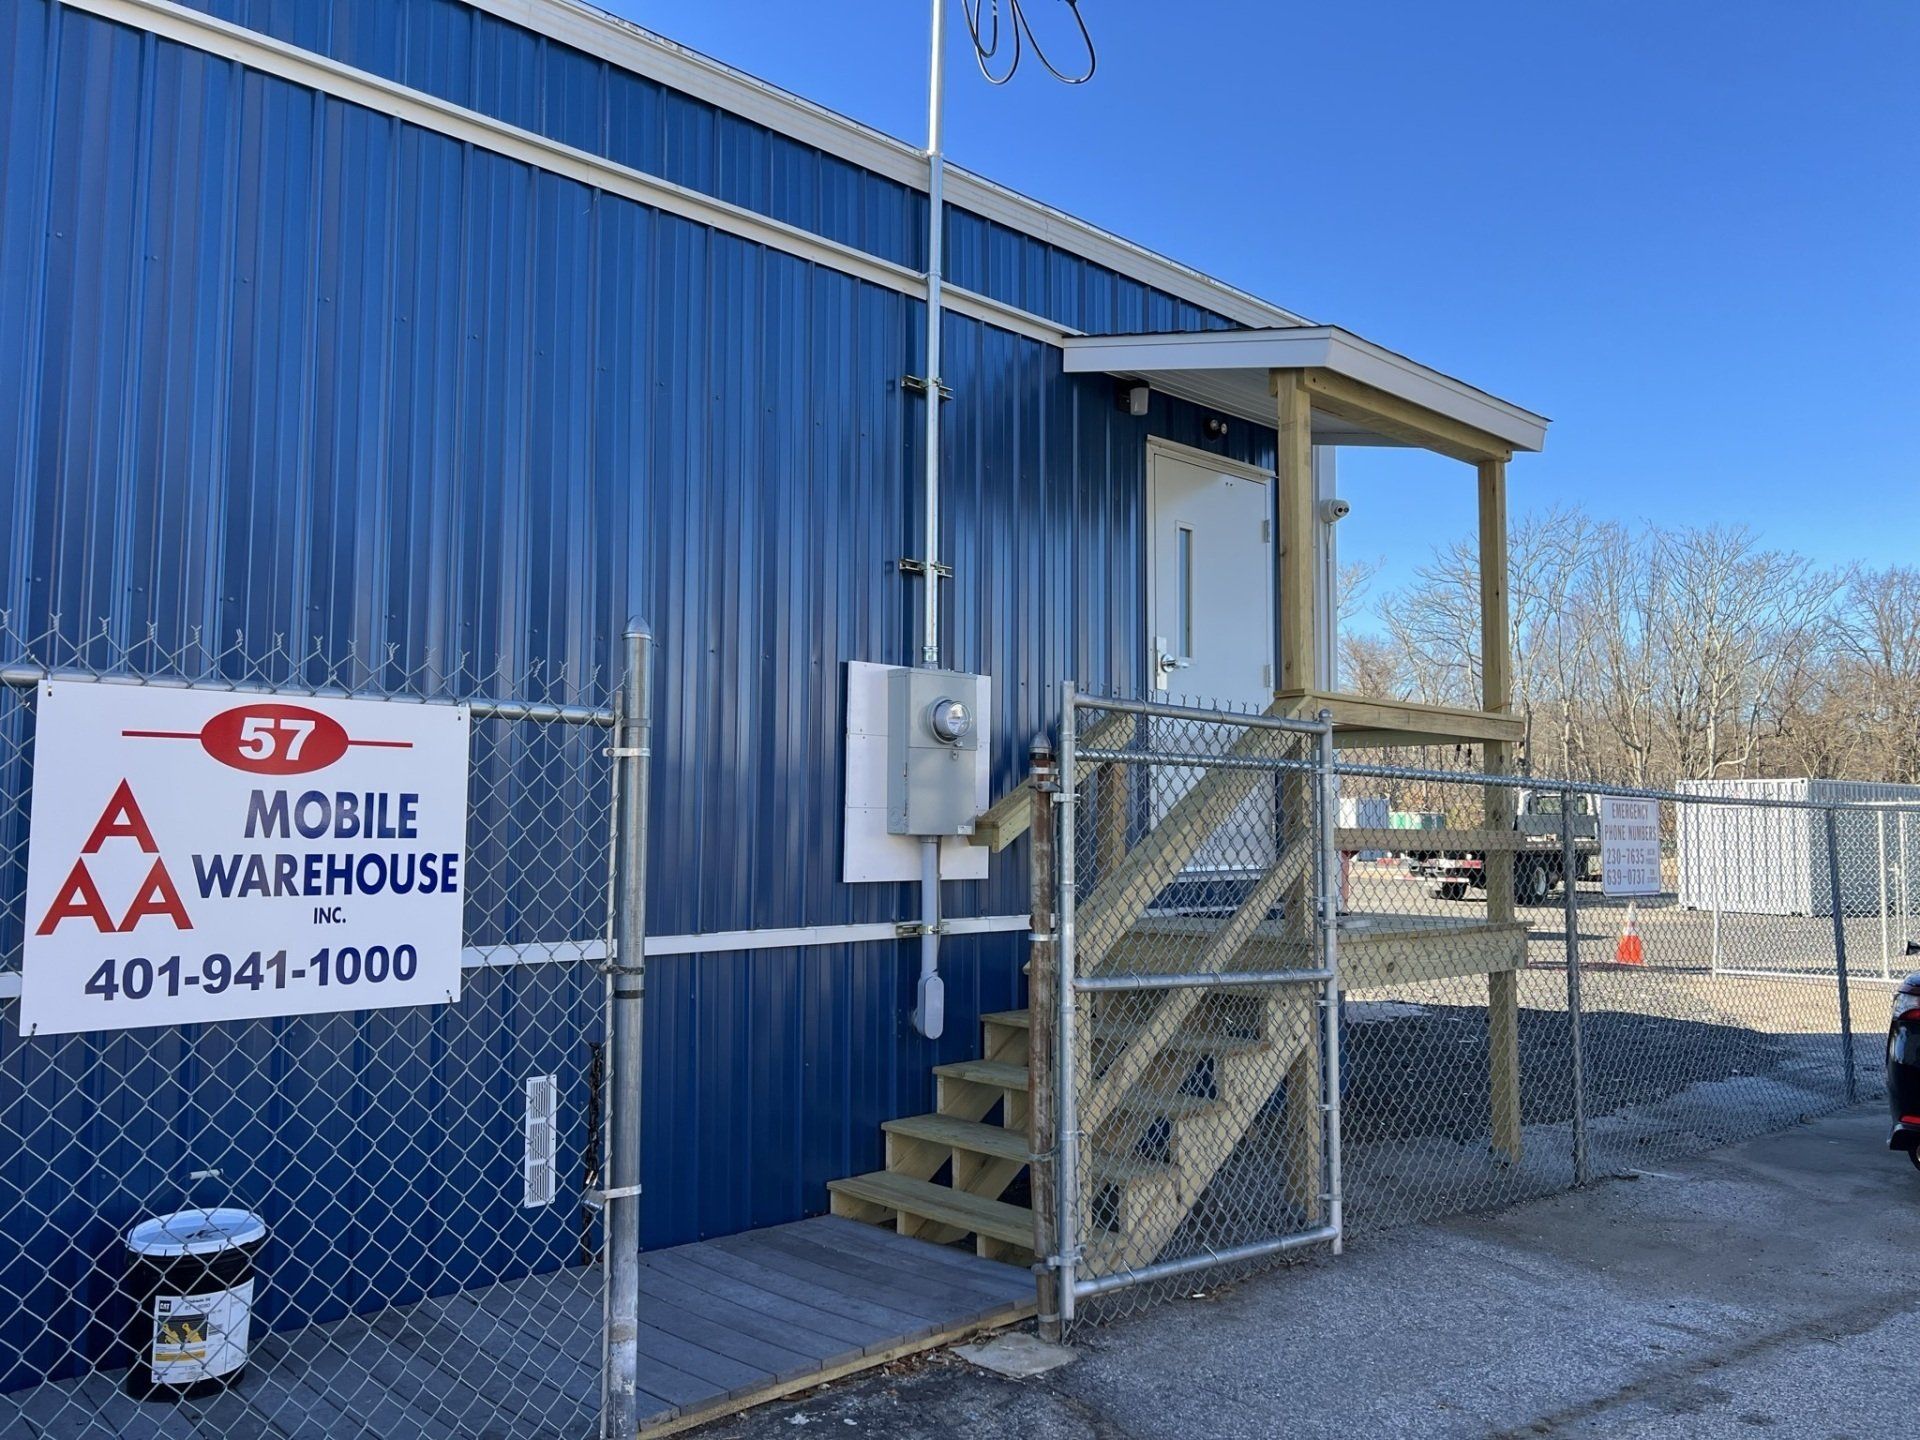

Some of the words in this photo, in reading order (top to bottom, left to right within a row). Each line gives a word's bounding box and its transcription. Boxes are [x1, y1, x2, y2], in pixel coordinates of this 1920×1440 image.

[238, 716, 316, 761] 57
[243, 789, 419, 839] MOBILE
[1611, 802, 1649, 819] EMERGENCY
[1604, 824, 1626, 841] PHONE
[1628, 825, 1657, 841] NUMBERS
[1606, 847, 1645, 865] 230-7635
[191, 852, 459, 899] WAREHOUSE
[1606, 868, 1645, 886] 639-0737
[313, 906, 348, 925] INC.
[84, 943, 418, 1001] 401-941-1000
